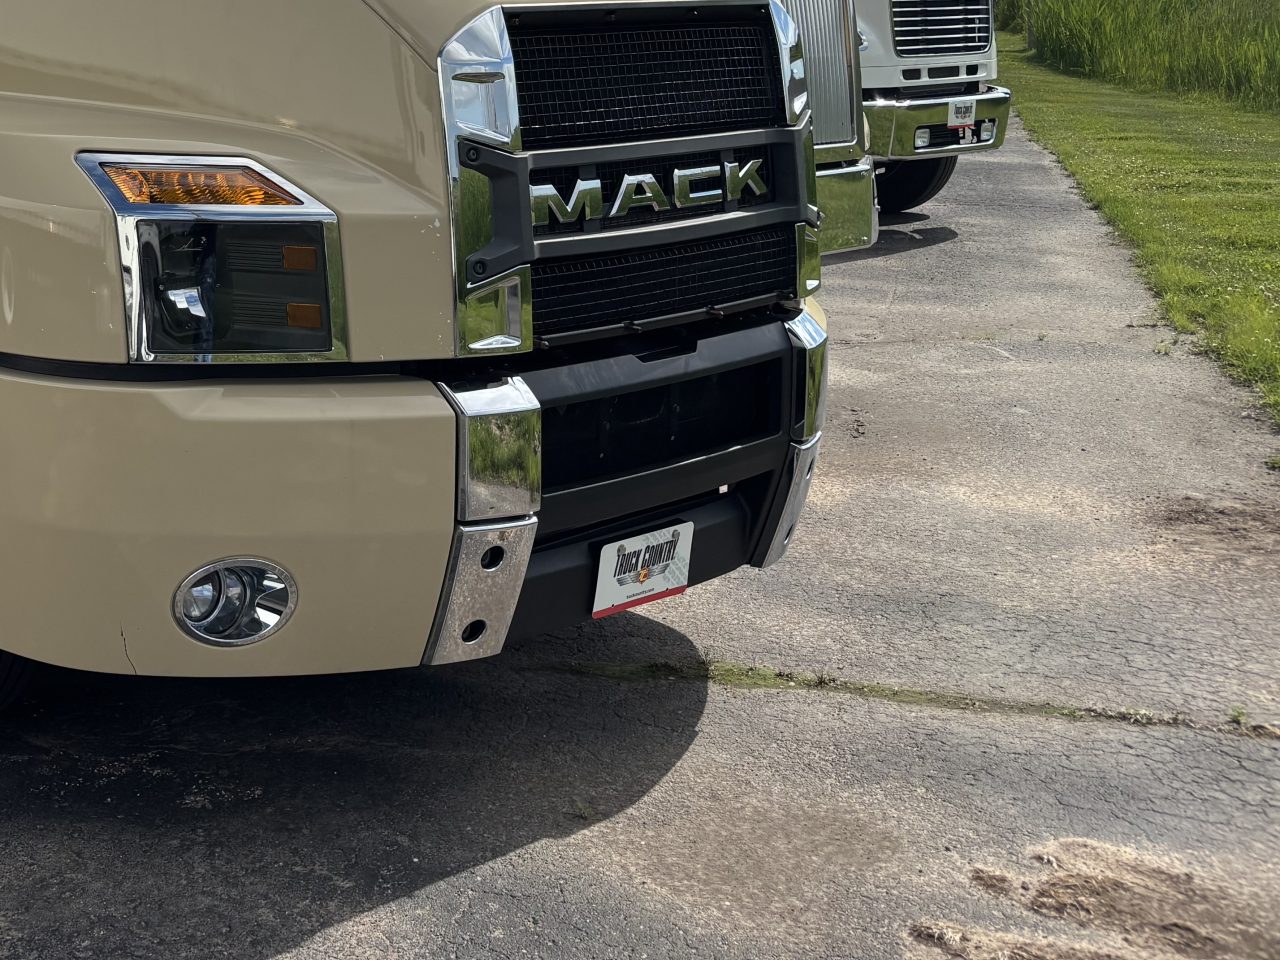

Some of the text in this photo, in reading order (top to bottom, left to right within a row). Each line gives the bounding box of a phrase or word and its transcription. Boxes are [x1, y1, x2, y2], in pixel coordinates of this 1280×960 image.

[529, 159, 768, 226] MACK
[613, 538, 679, 578] TRUCK COUNTRY
